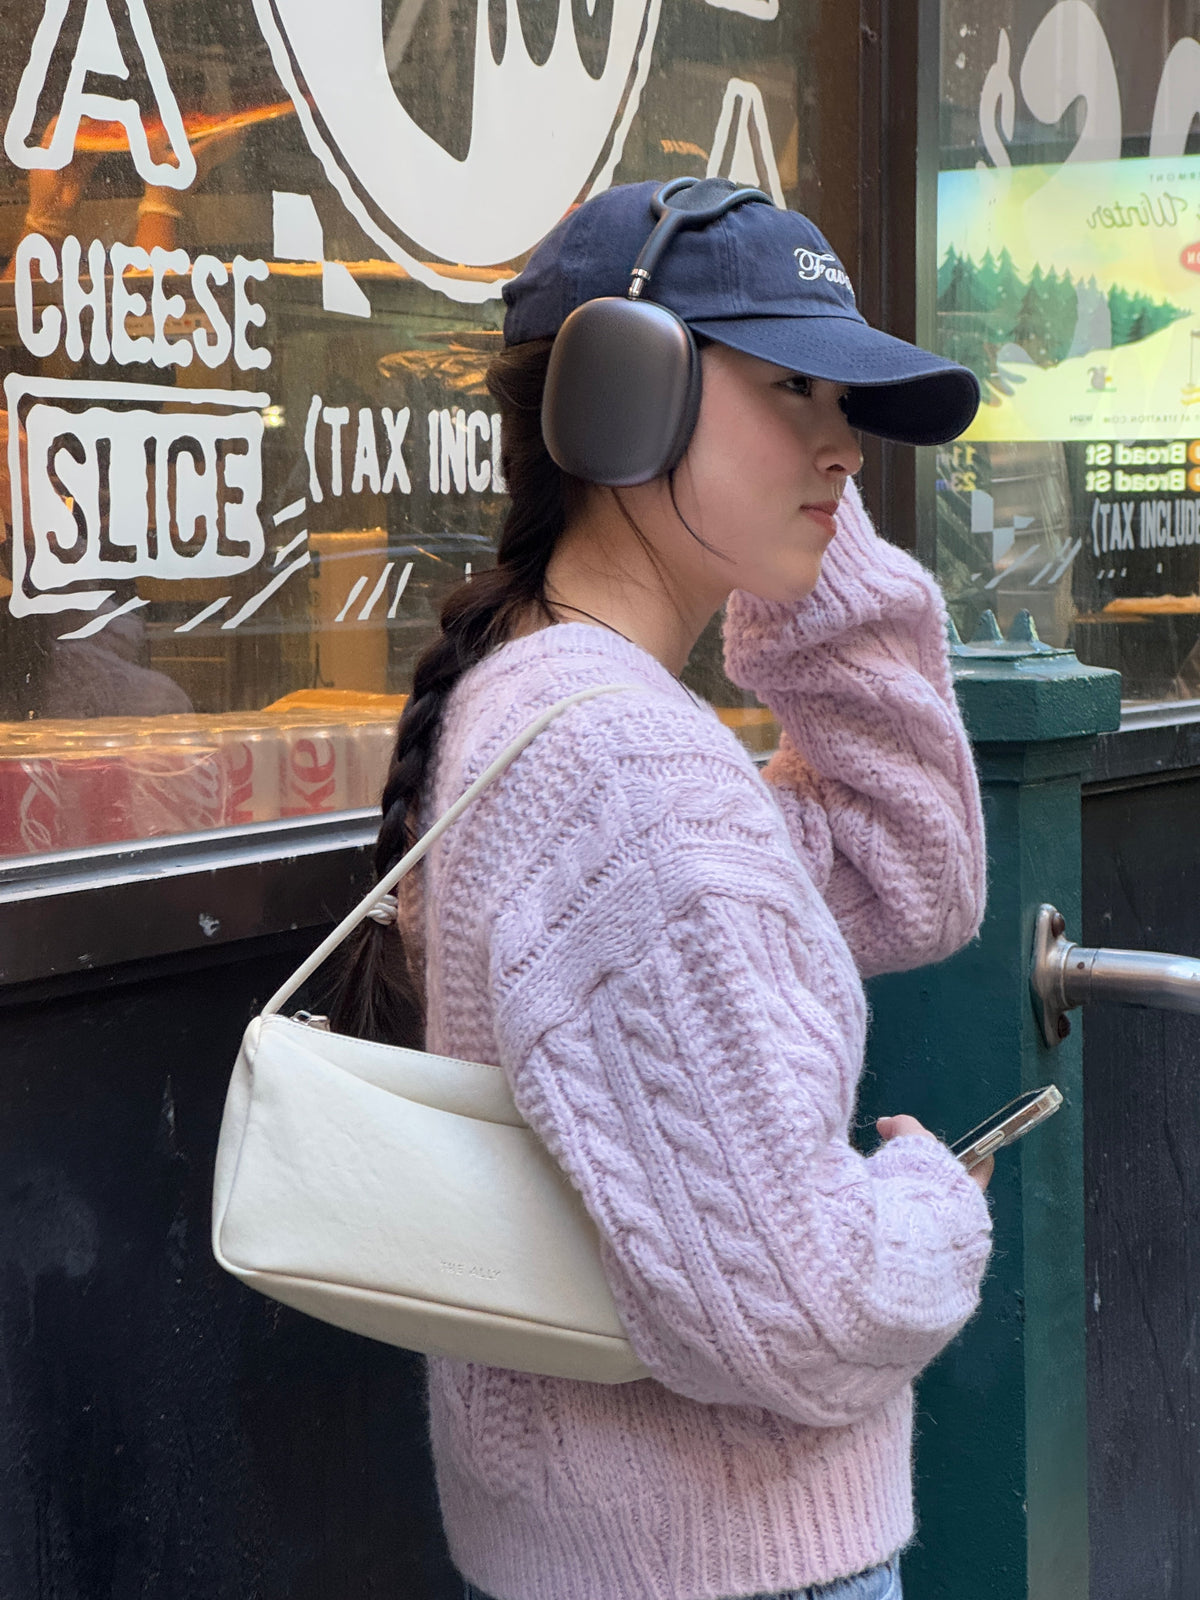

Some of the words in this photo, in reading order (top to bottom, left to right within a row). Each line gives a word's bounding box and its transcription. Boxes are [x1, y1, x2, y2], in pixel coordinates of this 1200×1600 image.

[15, 232, 272, 371] CHEESE
[46, 433, 253, 565] SLICE
[304, 394, 412, 503] (TAX
[1091, 497, 1135, 558] (TAX
